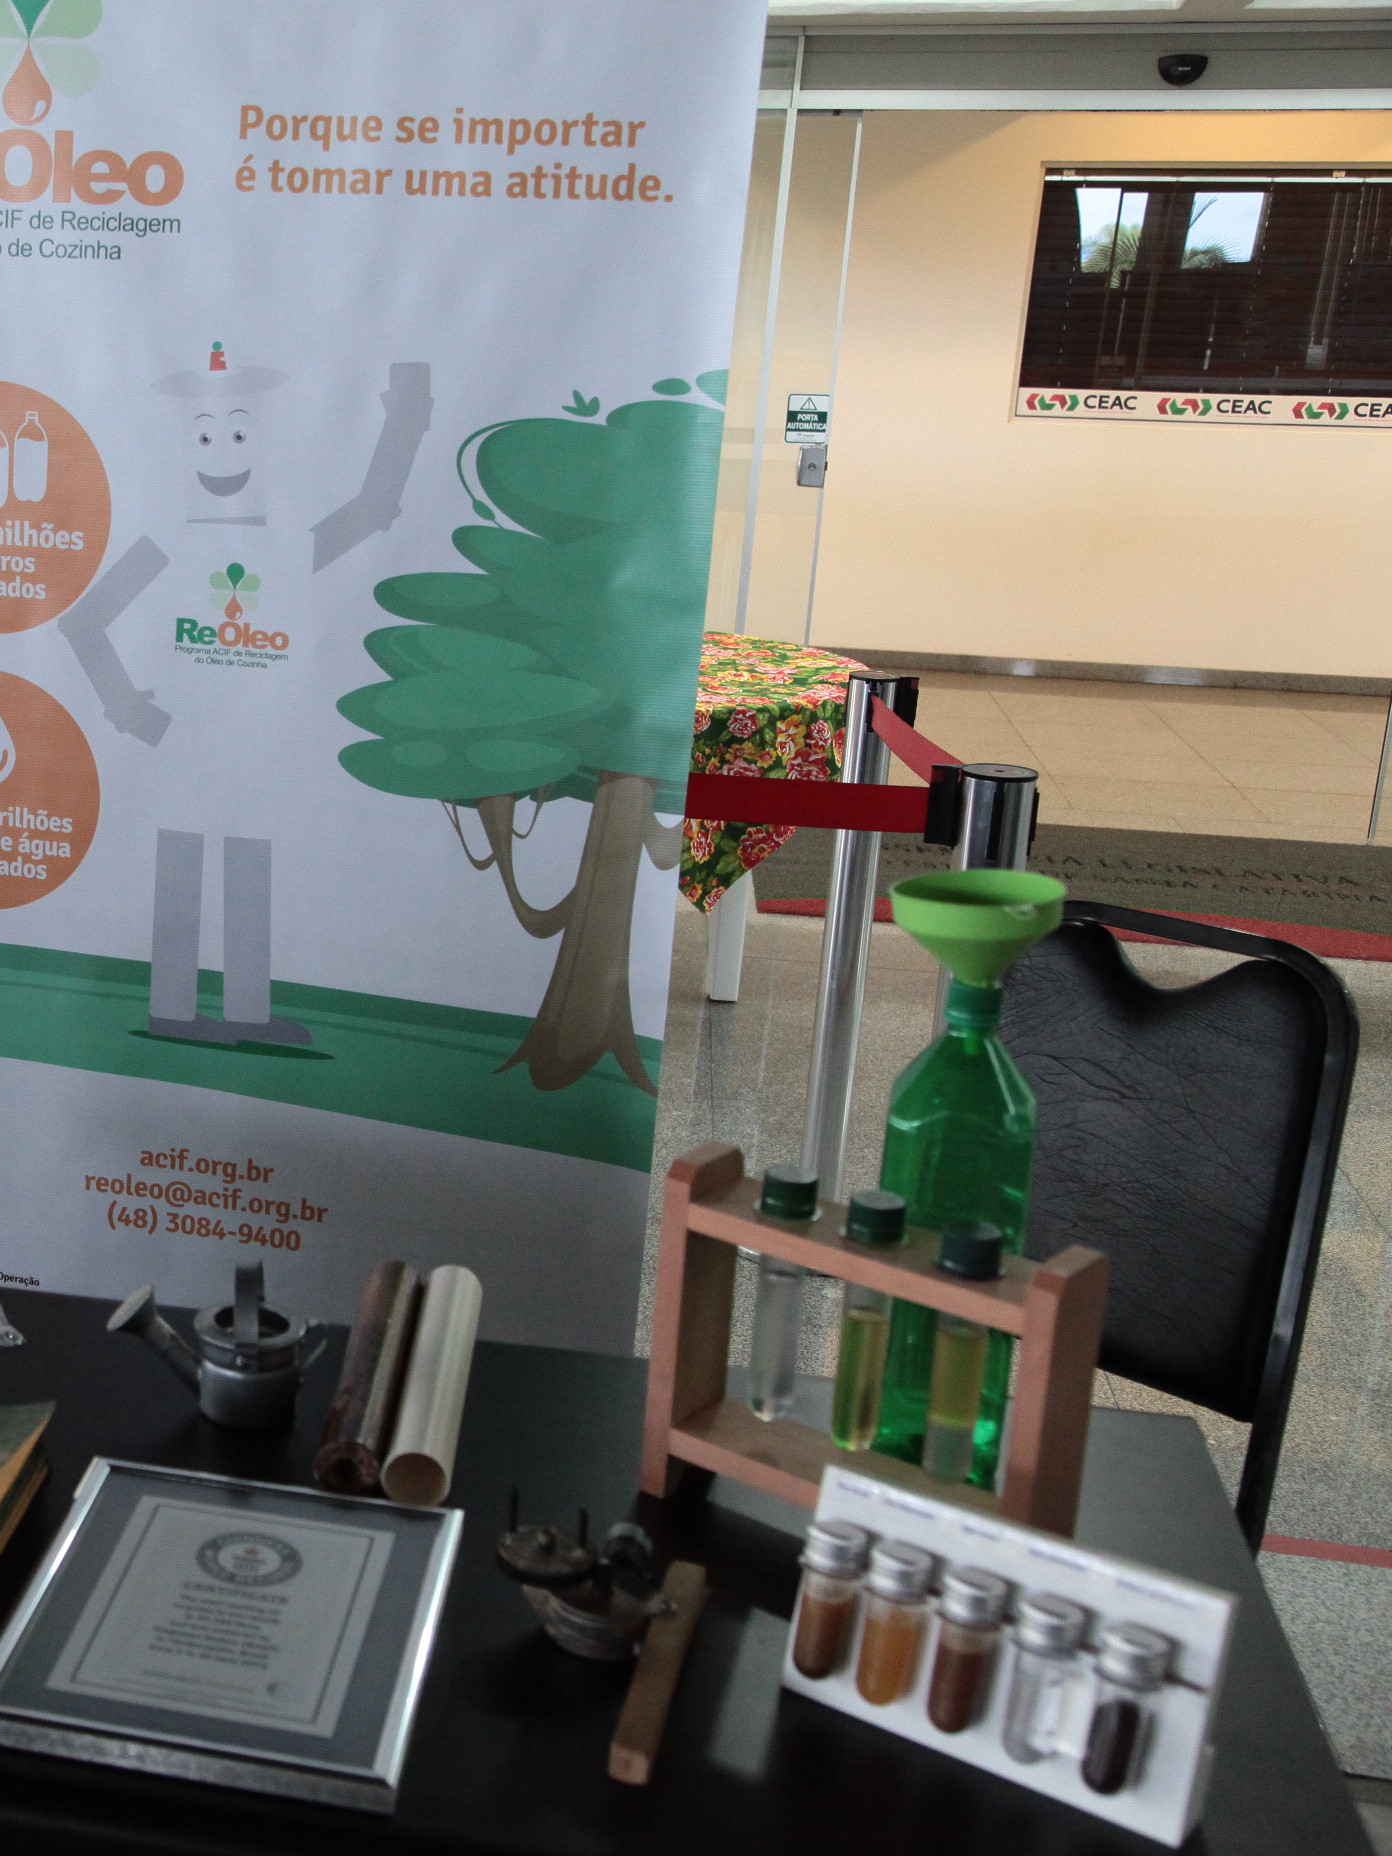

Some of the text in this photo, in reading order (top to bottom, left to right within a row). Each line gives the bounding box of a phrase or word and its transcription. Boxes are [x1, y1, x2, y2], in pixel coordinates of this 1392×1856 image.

[239, 104, 646, 156] Porque se importar
[235, 153, 674, 202] é tomar uma atitude.
[29, 210, 54, 229] de
[61, 211, 181, 238] Reciclagem
[8, 238, 32, 258] de
[39, 238, 122, 260] Cozinha
[1083, 394, 1138, 410] CEAC
[1216, 399, 1273, 415] CEAC
[1353, 402, 1392, 418] CEA
[797, 413, 819, 422] PORTA
[174, 644, 289, 662] Programa ACIF de Reciclagem
[194, 655, 268, 669] do Óleo de Cozinha
[17, 831, 71, 861] água
[139, 1147, 275, 1184] acif.org.br
[84, 1172, 328, 1225] reoleo@acif.org.br
[107, 1200, 302, 1252] (48) 3084-9400
